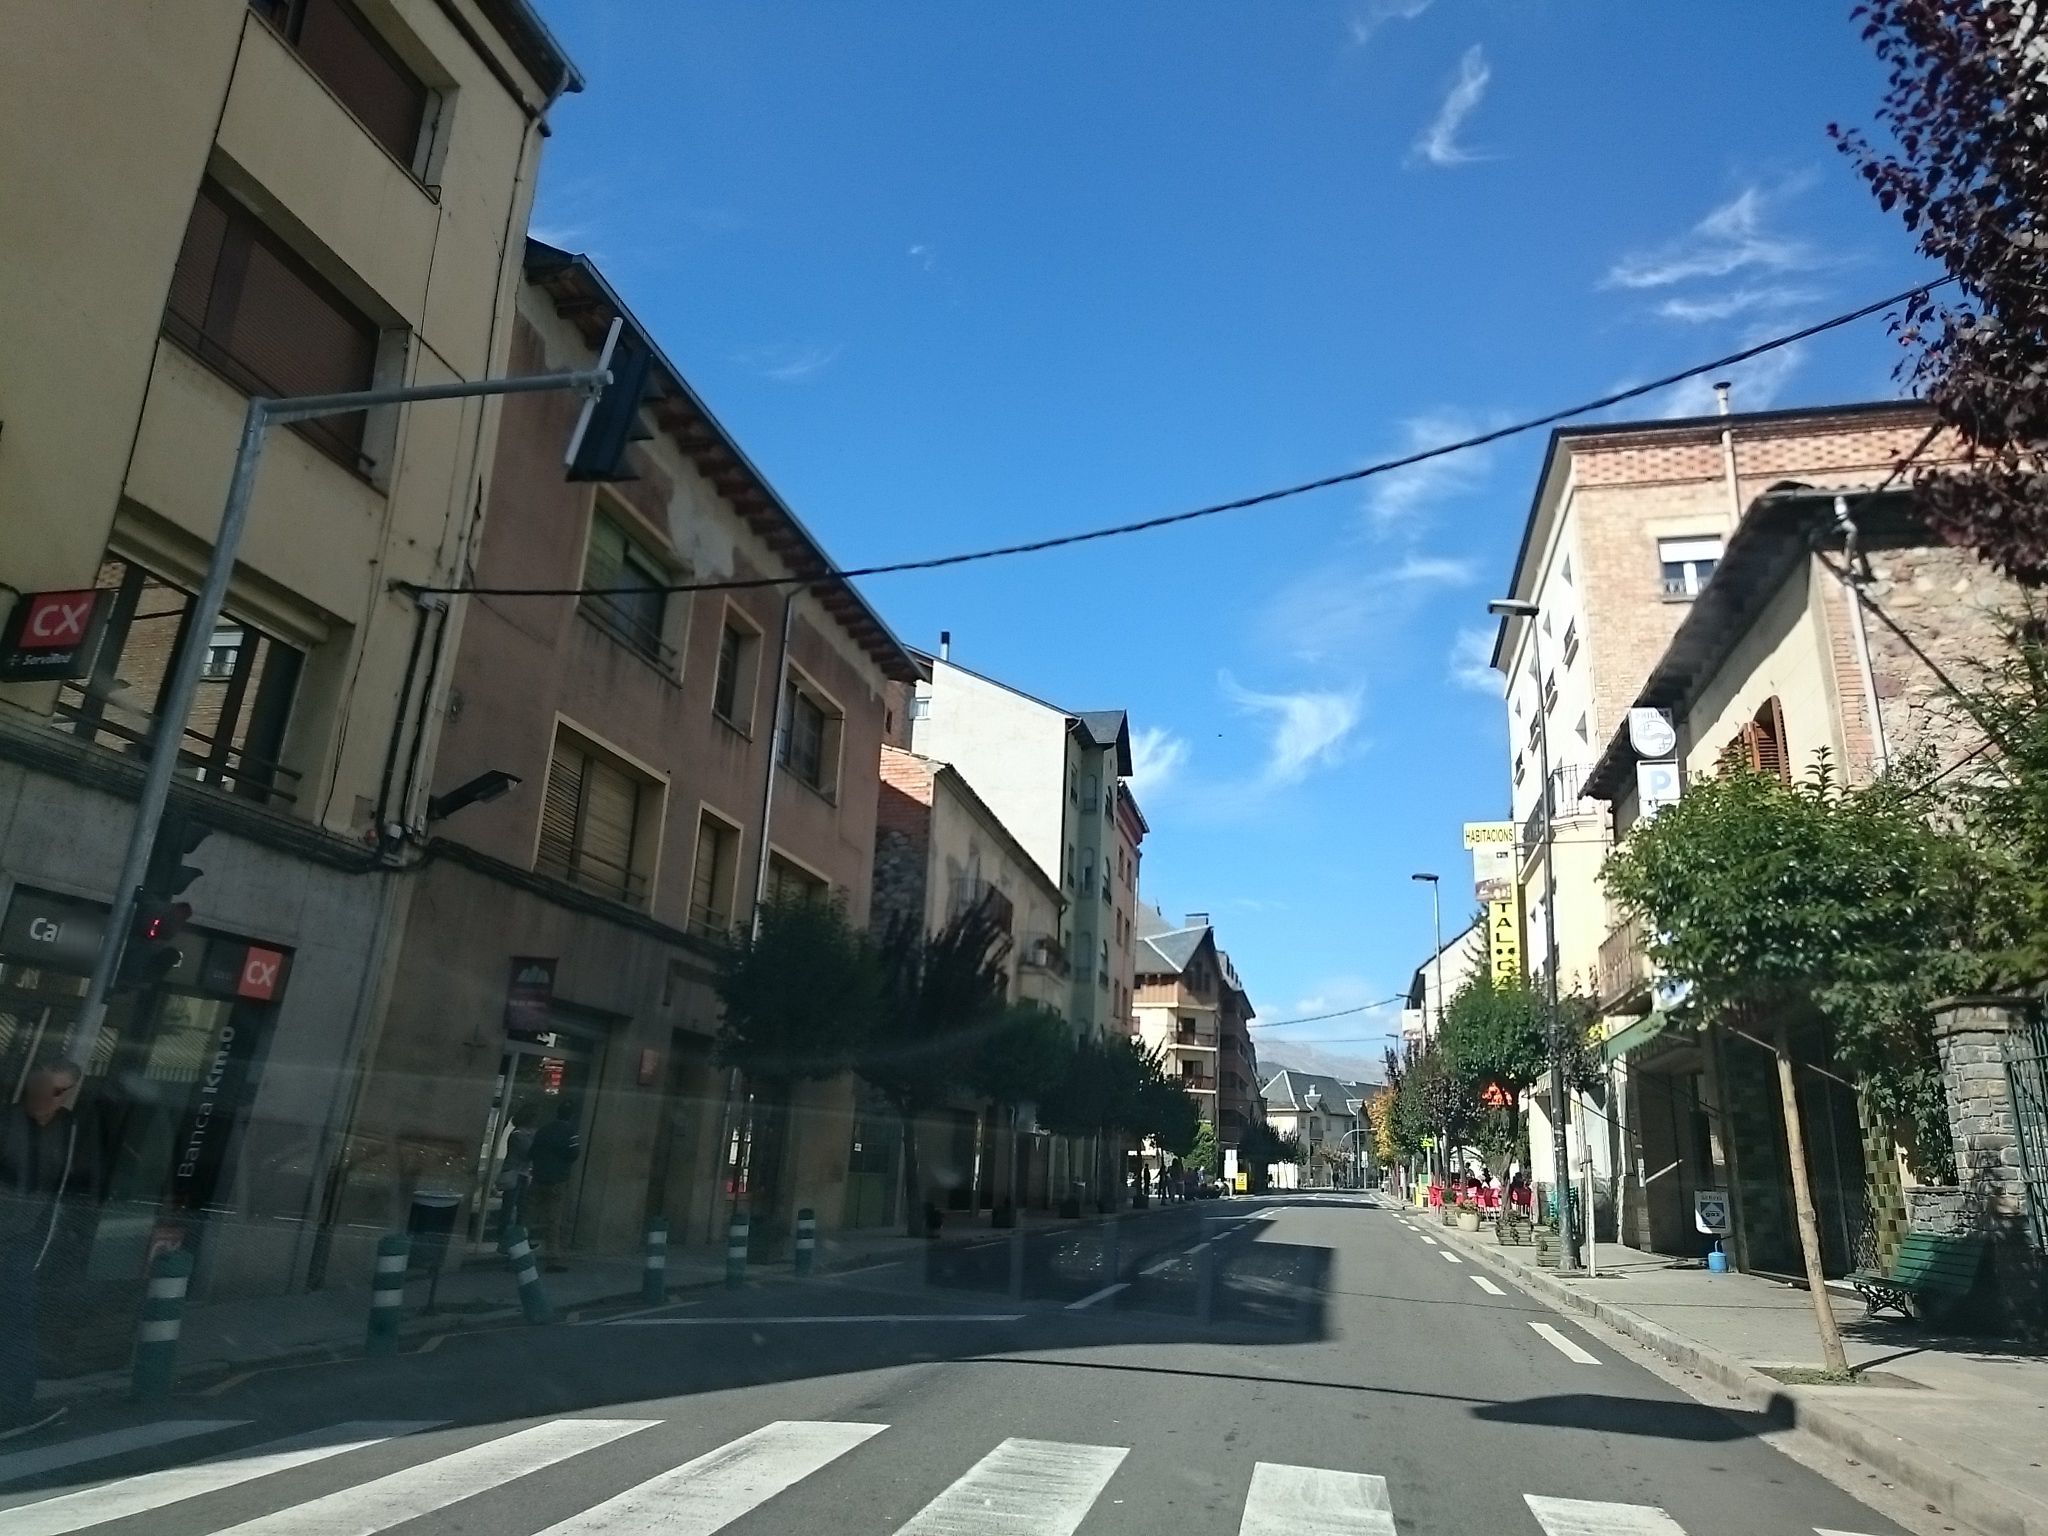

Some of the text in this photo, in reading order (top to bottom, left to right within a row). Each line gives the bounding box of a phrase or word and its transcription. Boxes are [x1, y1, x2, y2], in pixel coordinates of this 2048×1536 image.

[33, 603, 88, 636] CX
[1650, 770, 1671, 795] P
[1465, 827, 1514, 843] HABITACIONS
[246, 960, 276, 987] CX
[177, 1102, 214, 1178] Banca
